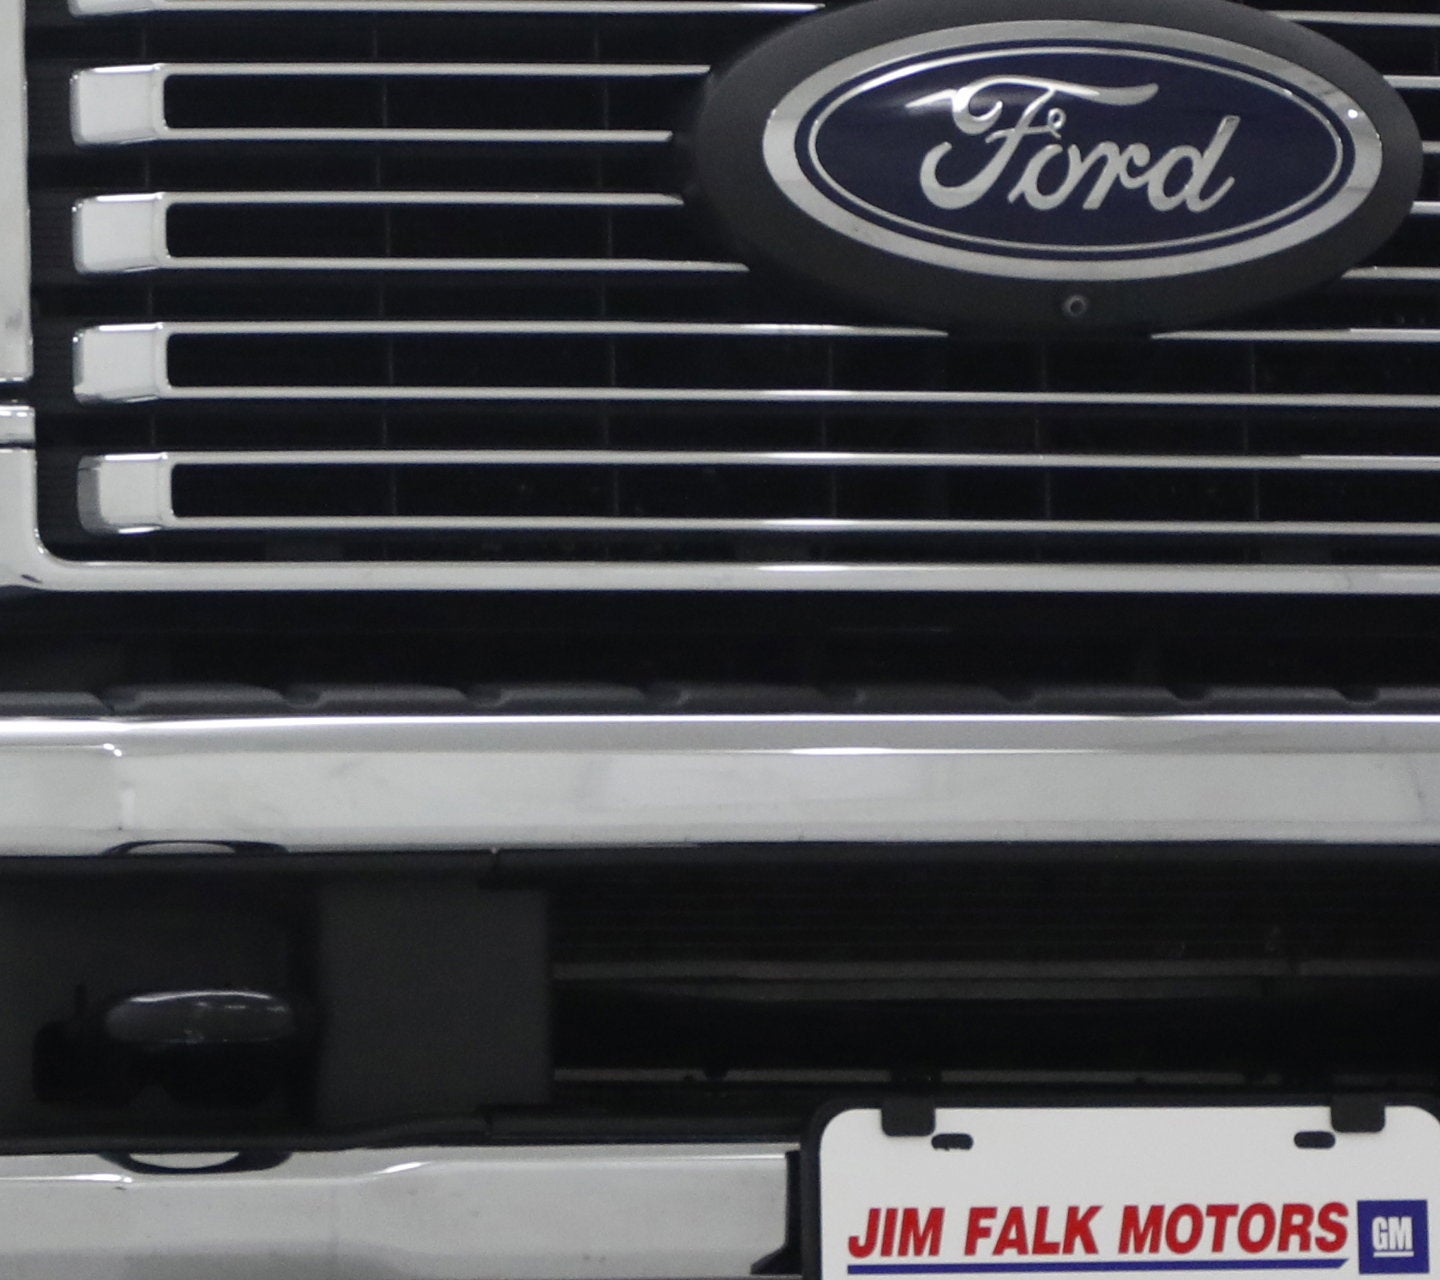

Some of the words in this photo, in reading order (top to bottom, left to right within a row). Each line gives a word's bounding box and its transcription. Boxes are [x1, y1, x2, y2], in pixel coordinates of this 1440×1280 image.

[905, 73, 1241, 212] Ford
[848, 1207, 945, 1258] JIM
[964, 1205, 1101, 1256] FALK
[1119, 1201, 1348, 1255] MOTORS
[1372, 1217, 1413, 1251] GM
